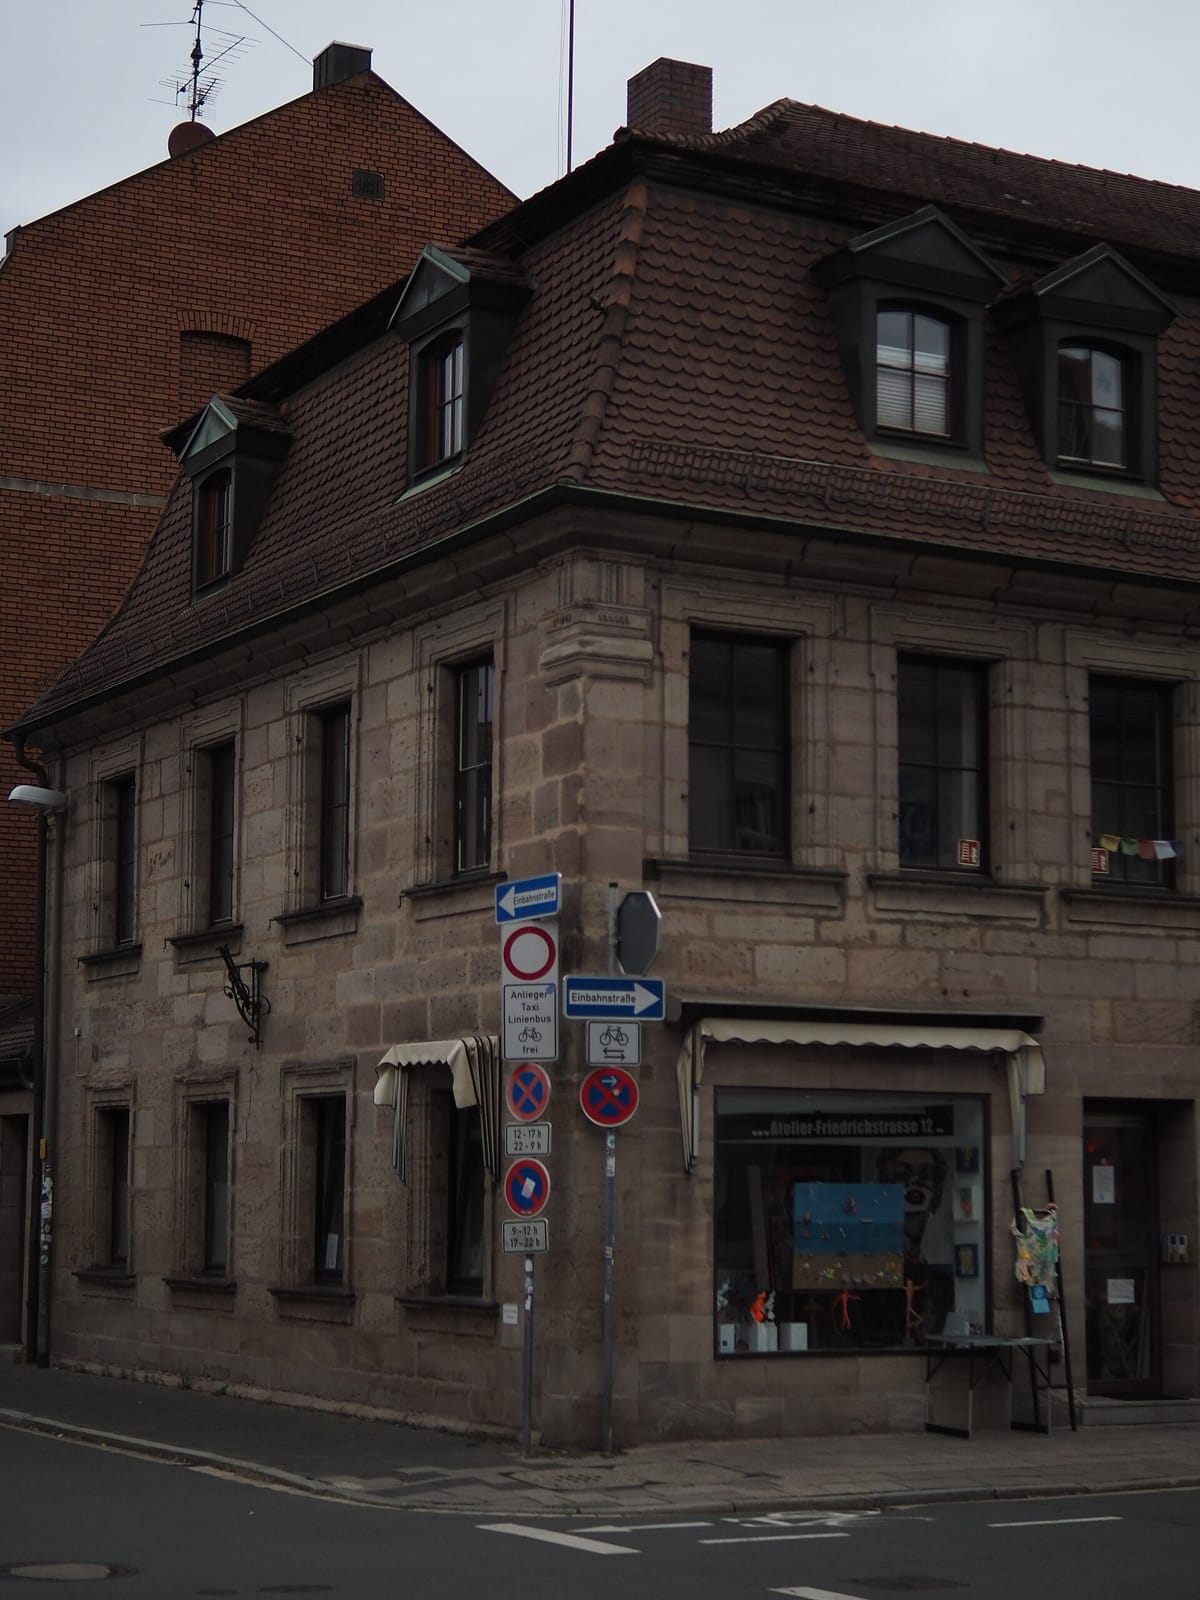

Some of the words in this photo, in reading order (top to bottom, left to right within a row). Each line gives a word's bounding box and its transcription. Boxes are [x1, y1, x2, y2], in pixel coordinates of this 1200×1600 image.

[513, 890, 554, 905] Einbahnstraße
[510, 991, 547, 1000] Anlieger
[571, 992, 636, 1003] Einbahnstraße
[521, 1003, 539, 1011] Taxi
[508, 1015, 552, 1024] Linienbus
[522, 1045, 538, 1054] frei
